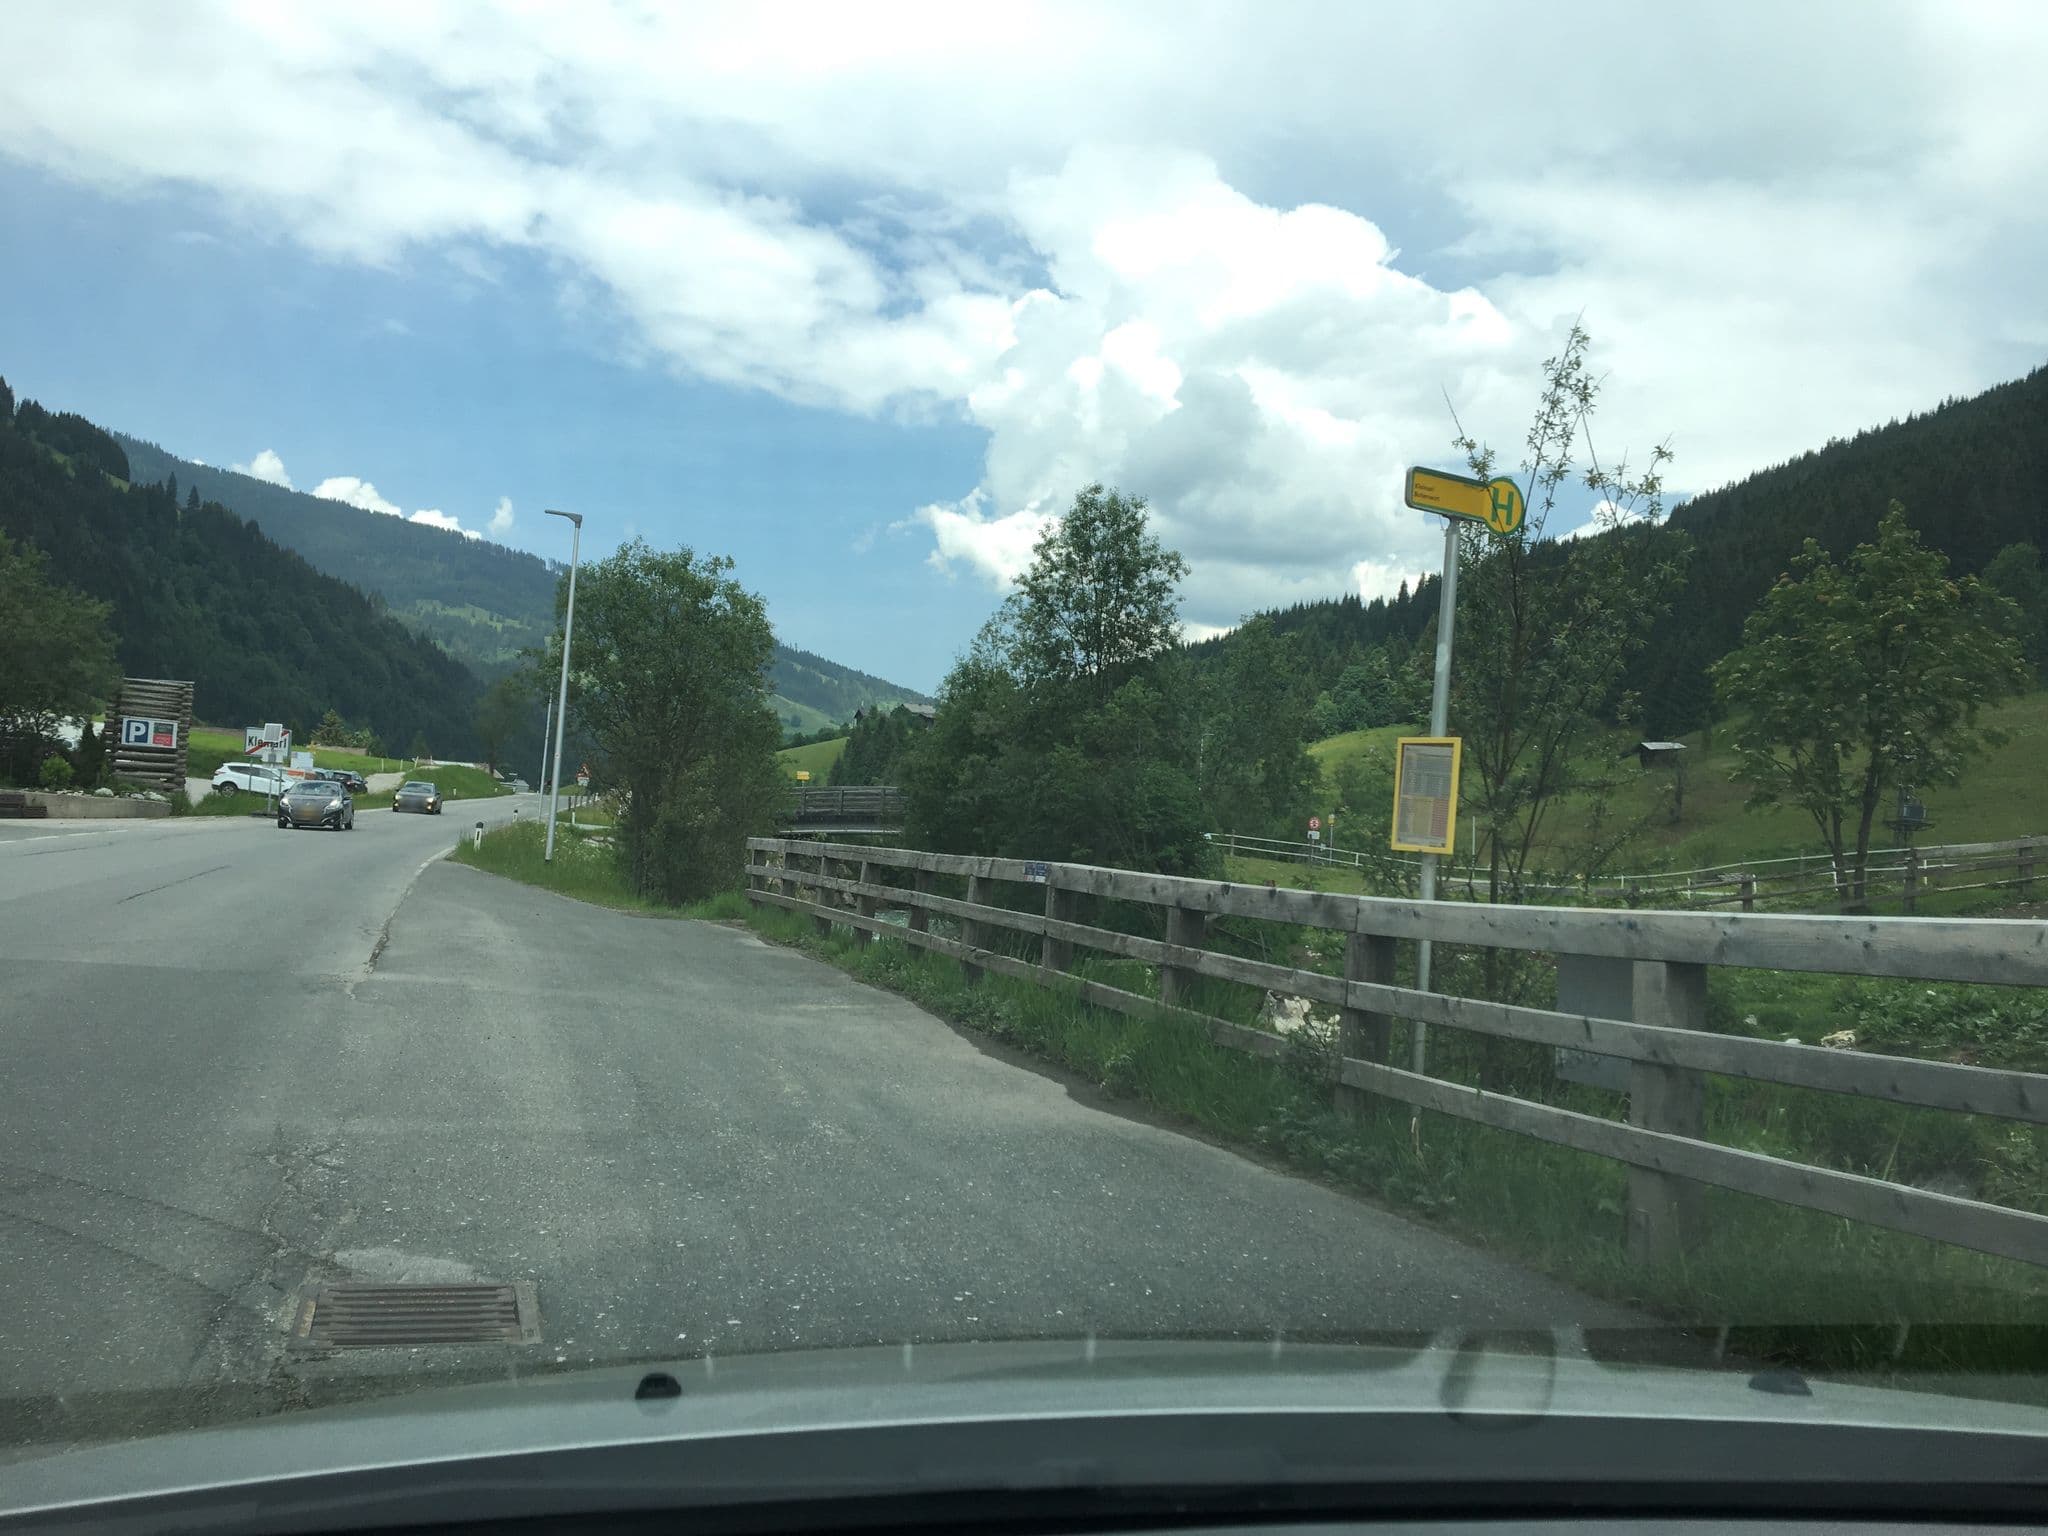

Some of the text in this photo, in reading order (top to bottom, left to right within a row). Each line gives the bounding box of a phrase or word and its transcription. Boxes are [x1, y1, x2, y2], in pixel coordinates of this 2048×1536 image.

[1491, 487, 1515, 526] H
[129, 721, 146, 742] P
[248, 735, 287, 748] Klenarl
